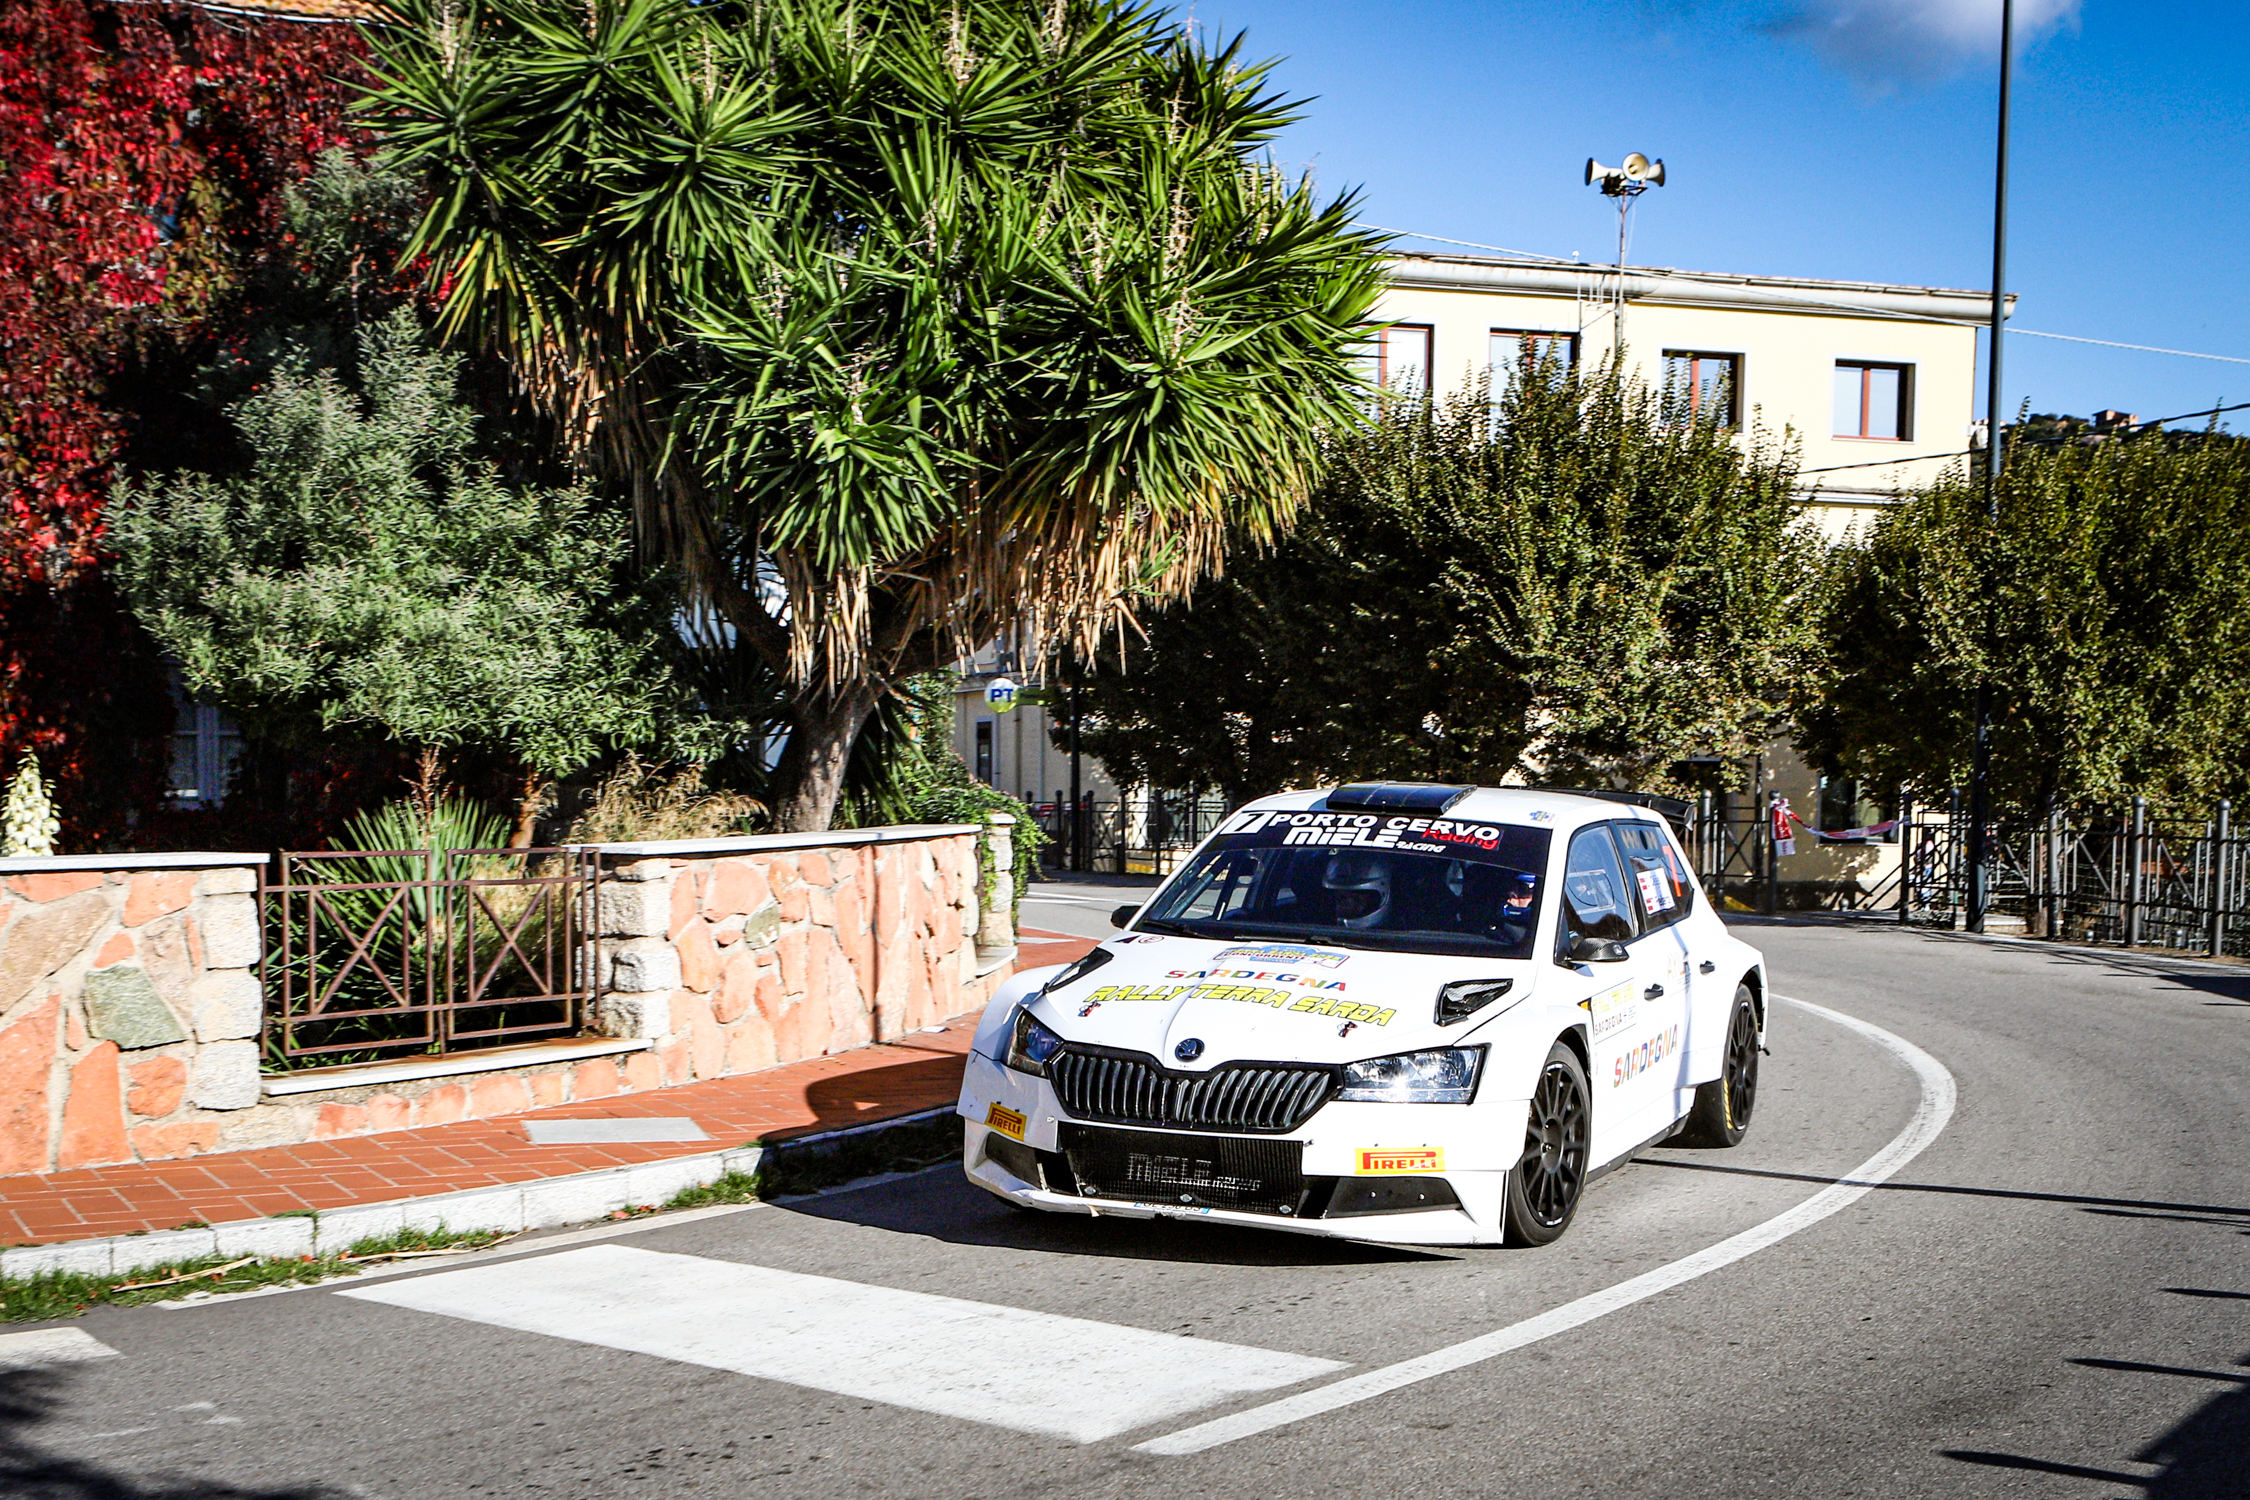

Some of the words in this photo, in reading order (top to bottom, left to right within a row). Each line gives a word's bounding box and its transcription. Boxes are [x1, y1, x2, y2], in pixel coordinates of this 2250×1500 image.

[990, 690, 1013, 702] PT
[1268, 813, 1378, 828] PORTO
[1386, 816, 1500, 841] CERVO
[1422, 828, 1499, 850] Racing
[1165, 969, 1346, 991] SARDEGNA
[1083, 985, 1194, 1002] RALLY
[1187, 983, 1292, 1008] TERRA
[1287, 996, 1397, 1027] SARDA
[1613, 1023, 1678, 1088] SARDEGNA
[988, 1106, 1022, 1135] PIRELLI
[1362, 1151, 1437, 1170] PIRELLI
